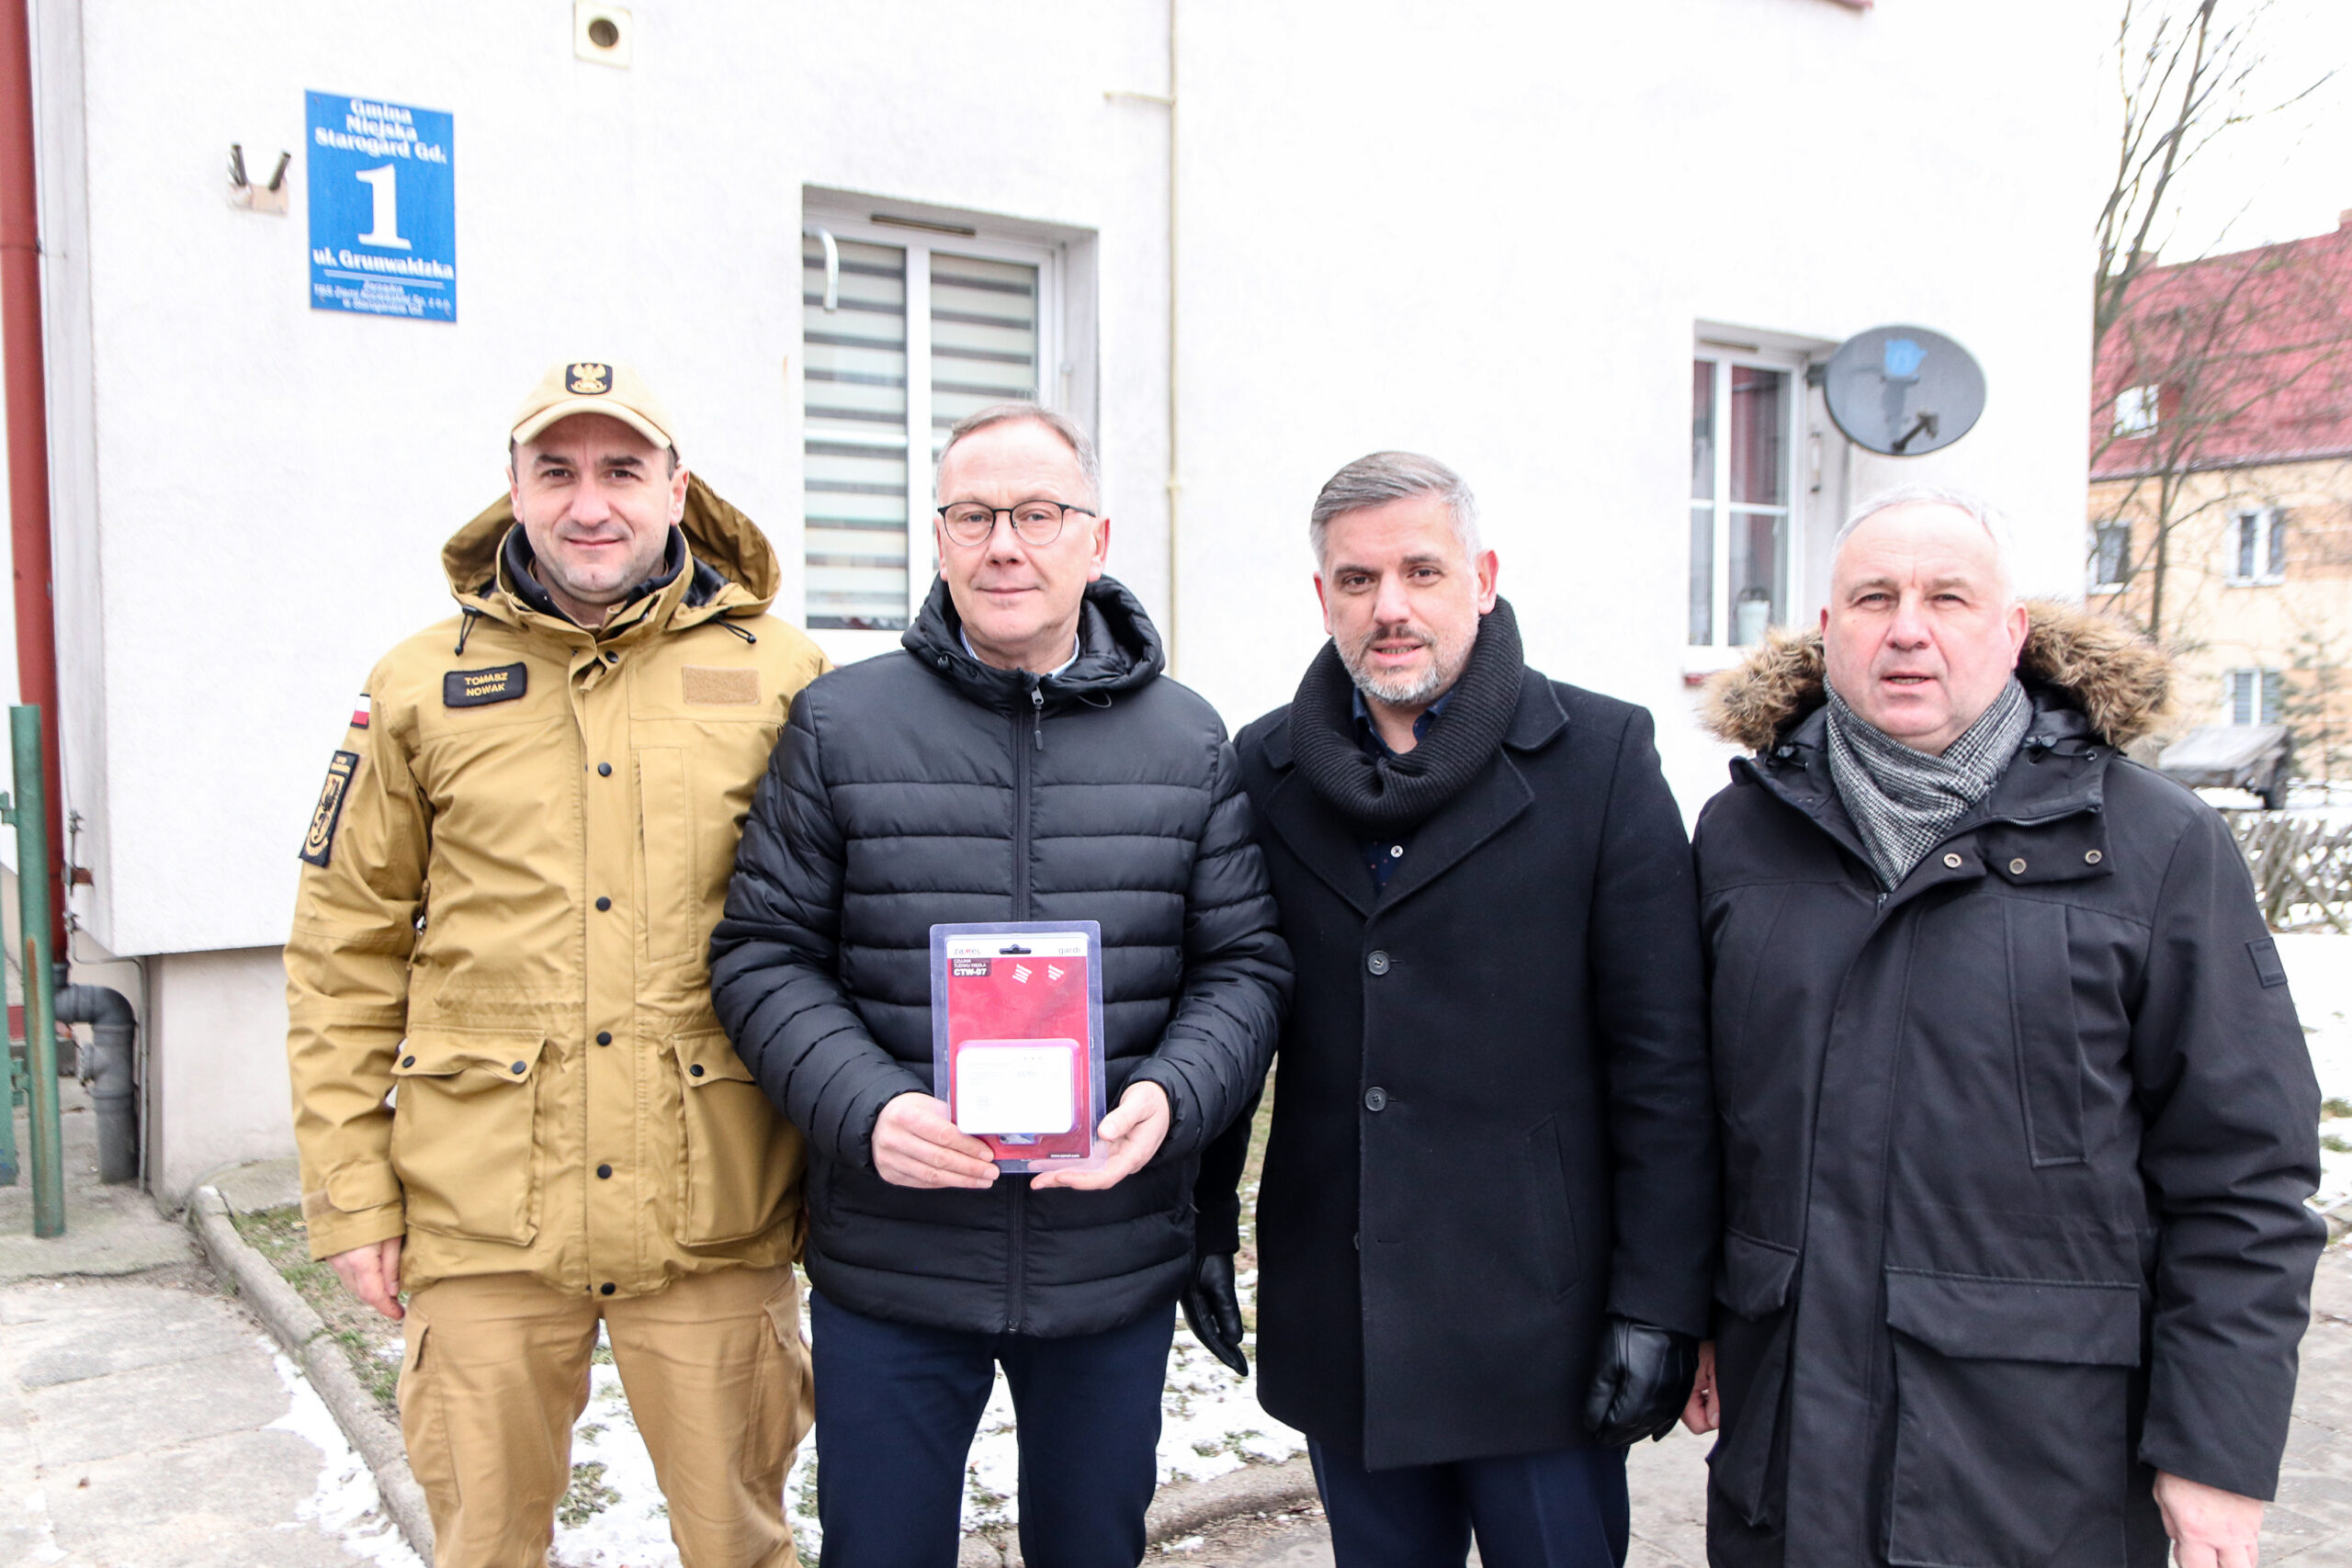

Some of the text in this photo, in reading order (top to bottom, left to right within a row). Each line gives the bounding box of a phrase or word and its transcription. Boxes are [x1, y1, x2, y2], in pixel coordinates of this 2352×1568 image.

[350, 97, 413, 126] Gmina
[345, 113, 419, 143] Miejska
[314, 126, 447, 164] Starogard Gd.
[355, 163, 413, 251] 1
[312, 246, 455, 280] ul. Grunwaldzka
[464, 671, 508, 686] TOMASZ
[466, 682, 505, 696] NOWAK
[954, 967, 988, 976] CTW-07
